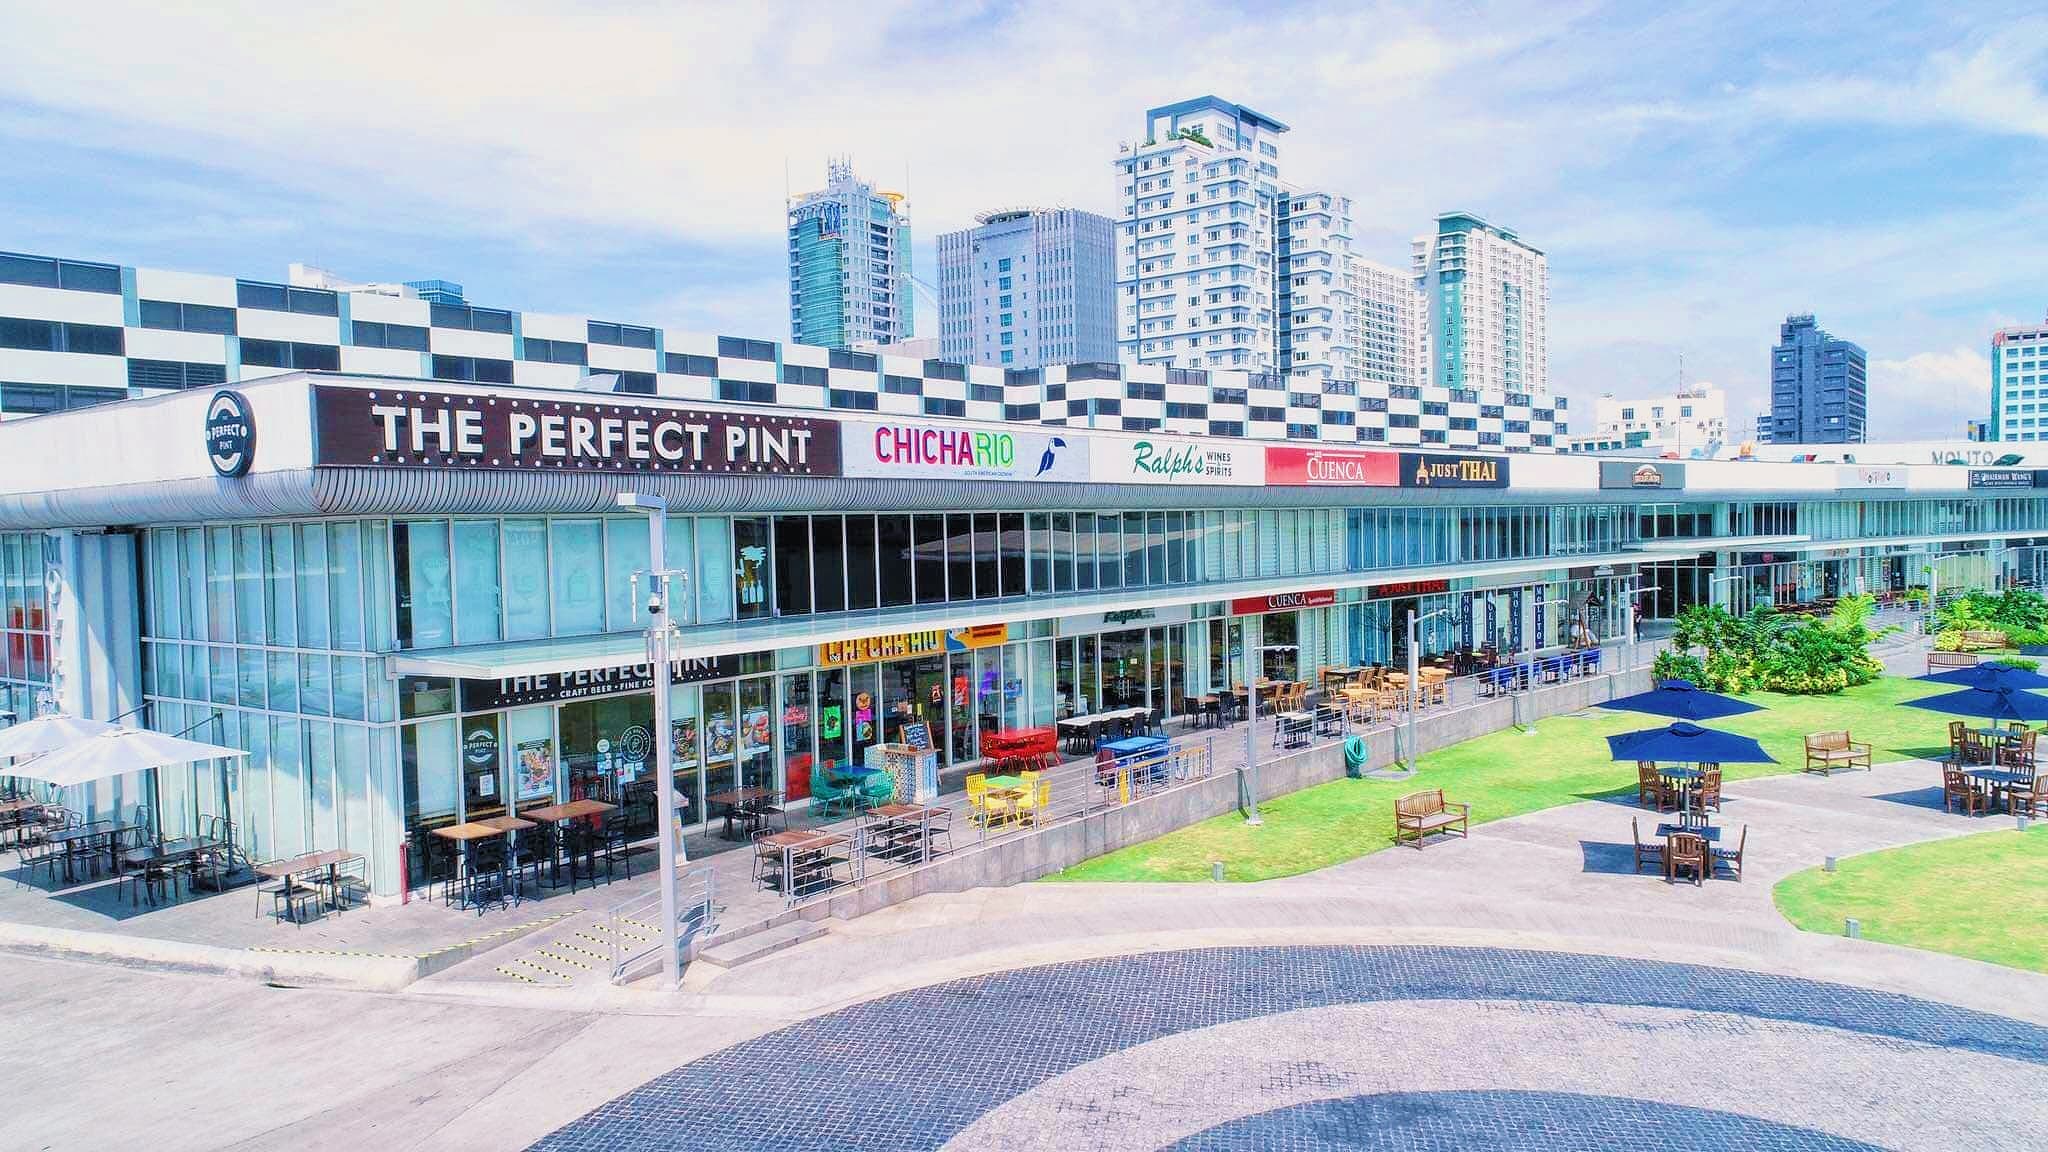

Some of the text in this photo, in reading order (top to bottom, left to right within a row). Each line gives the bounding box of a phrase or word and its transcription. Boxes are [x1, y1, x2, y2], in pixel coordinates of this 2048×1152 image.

[211, 424, 240, 440] PERFECT
[372, 405, 812, 465] THE PERFECT PINT
[219, 440, 232, 450] PINT
[874, 426, 1014, 468] CHICHARIO
[1133, 441, 1205, 481] Ralph's
[1206, 451, 1231, 461] WINES
[1206, 466, 1232, 477] SPIRITS
[1307, 457, 1364, 479] CUENCA
[1430, 460, 1497, 481] JUST THAI
[1268, 593, 1307, 609] CUENCA
[559, 662, 647, 687] PERFEC
[560, 687, 587, 698] CRAFT
[591, 685, 612, 695] BEER
[619, 680, 640, 691] FINE
